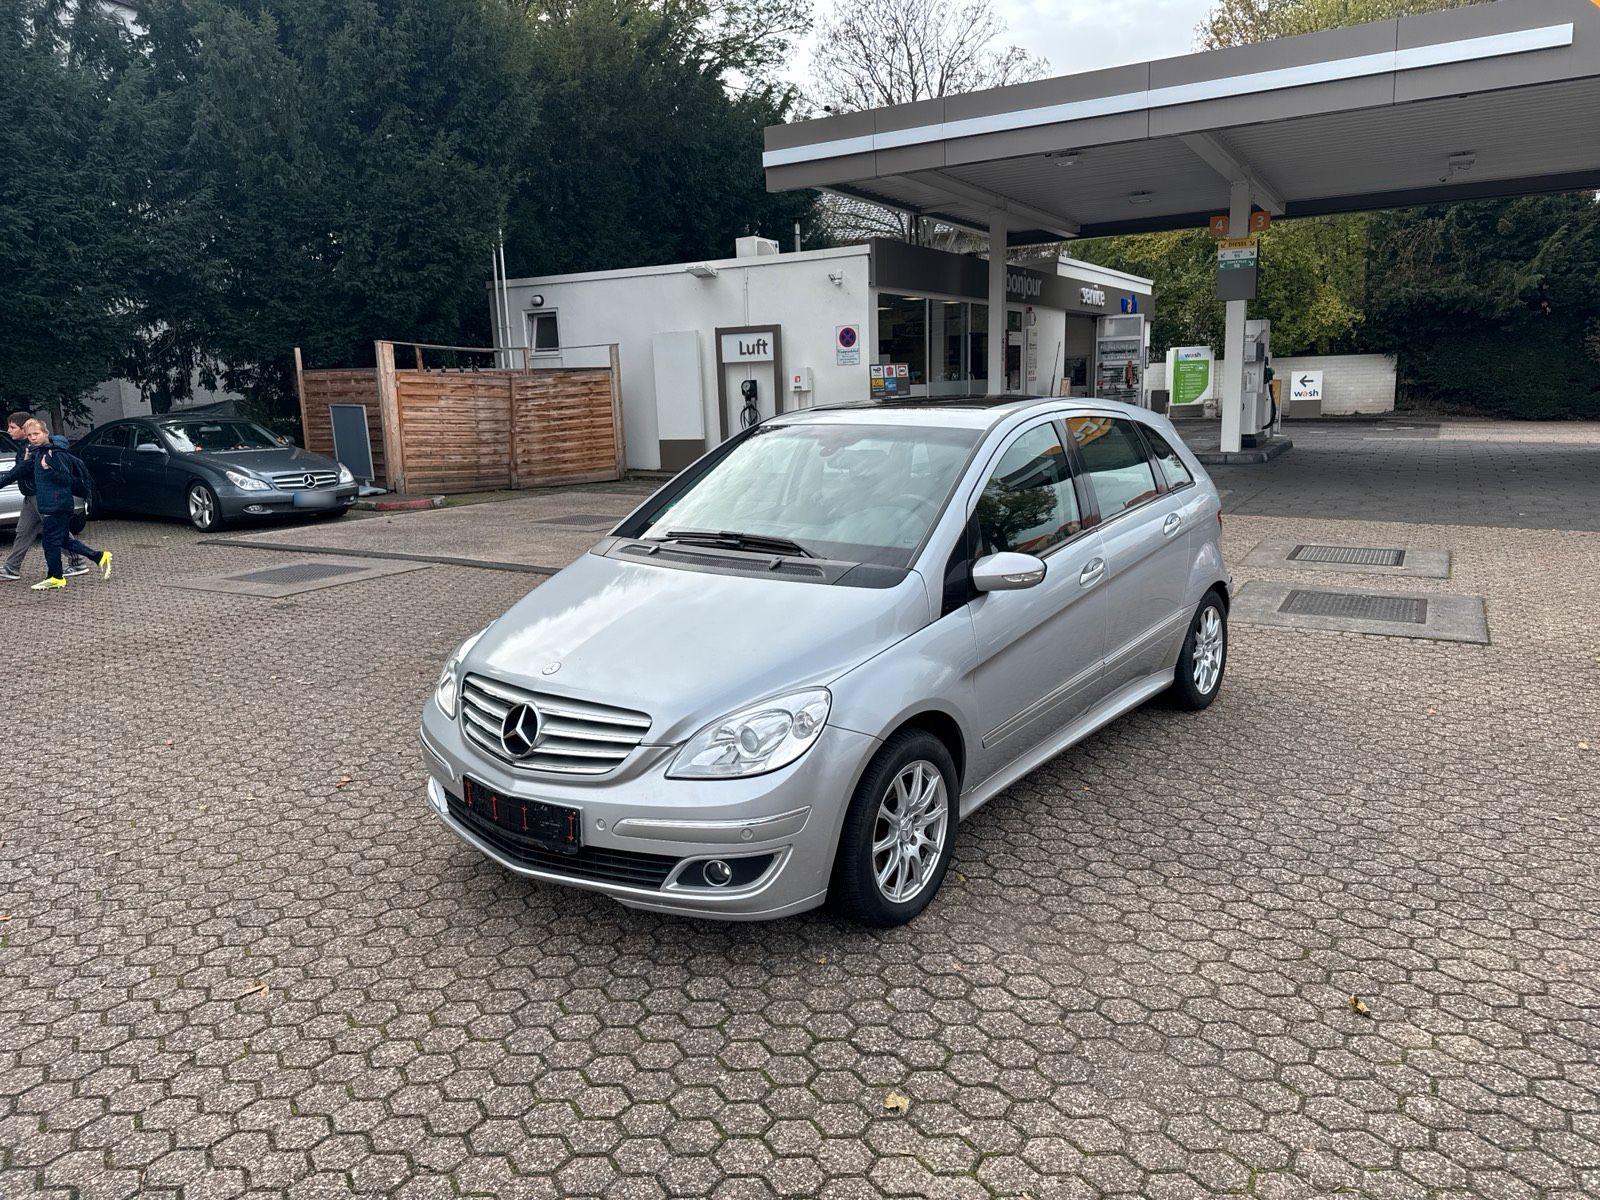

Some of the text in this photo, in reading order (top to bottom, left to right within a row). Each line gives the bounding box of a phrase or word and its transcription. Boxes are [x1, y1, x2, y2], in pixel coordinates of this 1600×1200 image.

[1215, 220, 1224, 231] 4
[1256, 215, 1265, 228] 3
[738, 338, 768, 356] Luft
[1294, 389, 1319, 397] wash
